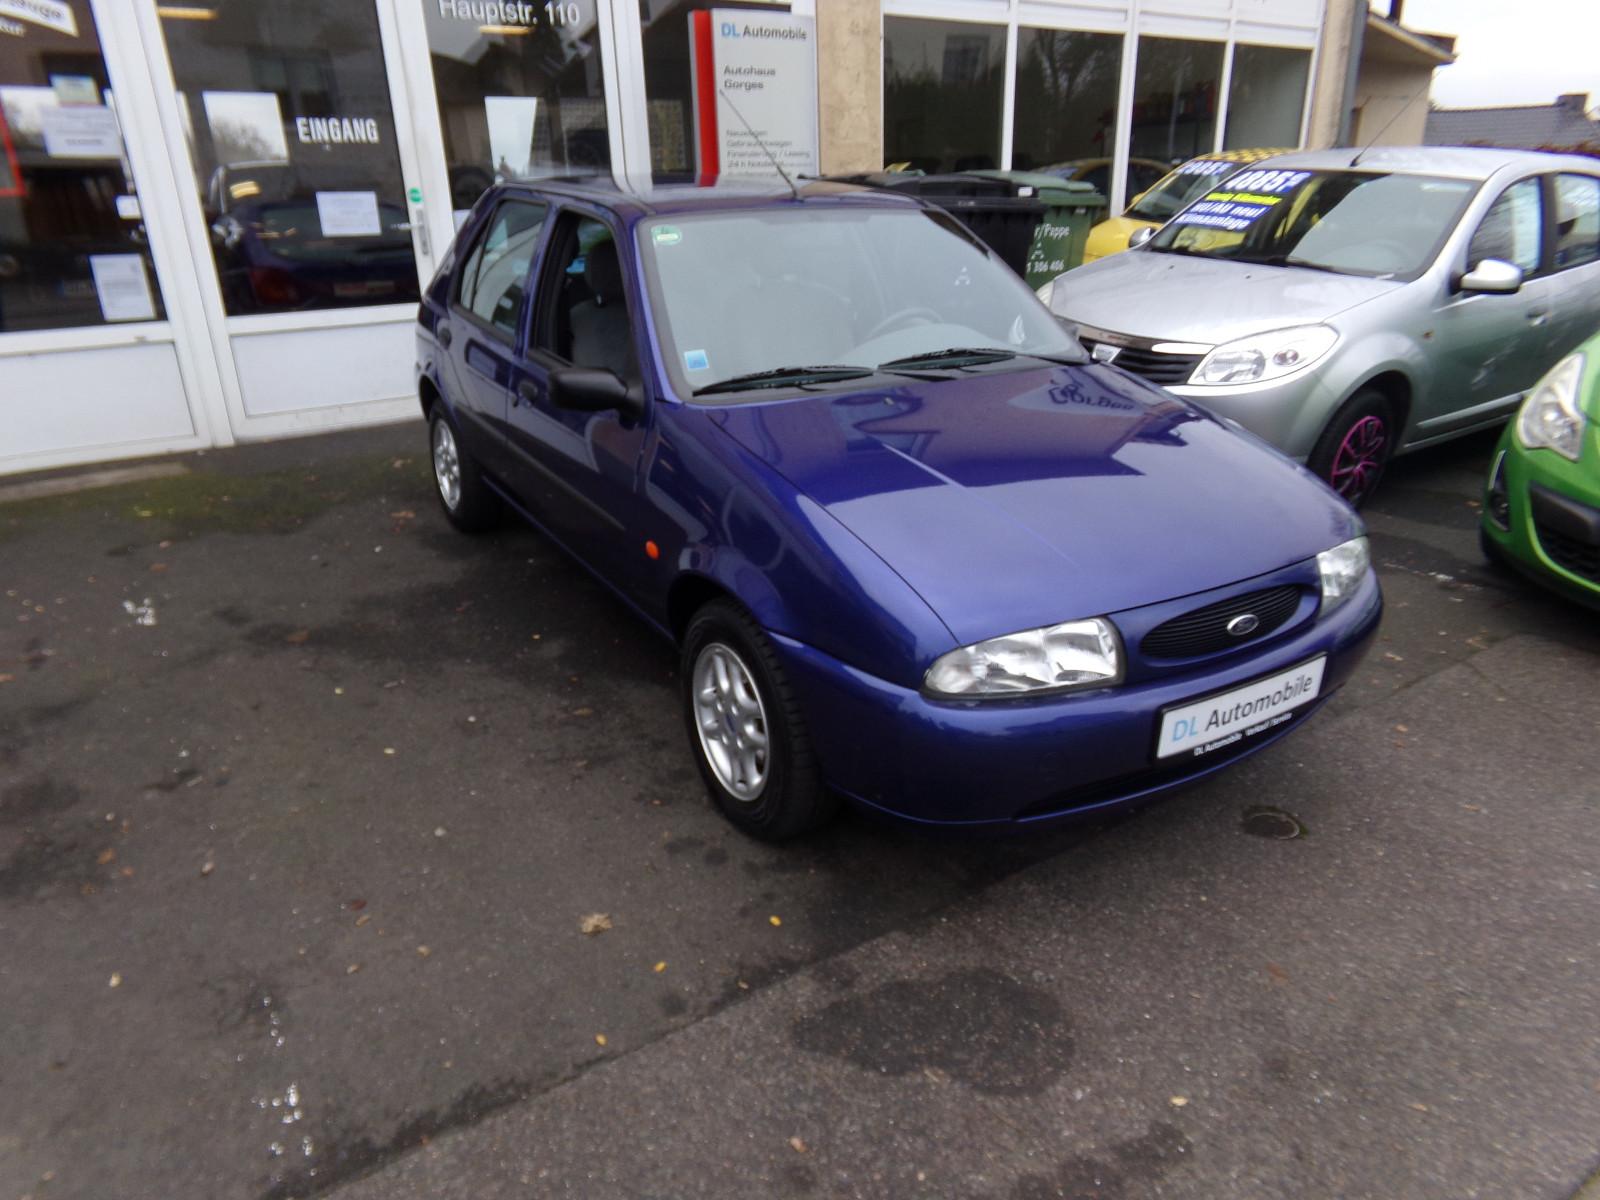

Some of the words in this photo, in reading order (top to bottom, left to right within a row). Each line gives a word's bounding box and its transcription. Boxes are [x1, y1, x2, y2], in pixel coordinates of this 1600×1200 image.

[438, 0, 538, 25] Hauptstr.
[546, 2, 580, 27] 110
[721, 22, 741, 38] DL
[743, 24, 808, 40] Automobile
[724, 65, 776, 77] Autohaus
[295, 115, 380, 144] EINGANG
[1172, 715, 1200, 743] DL
[1204, 674, 1313, 733] Automobile
